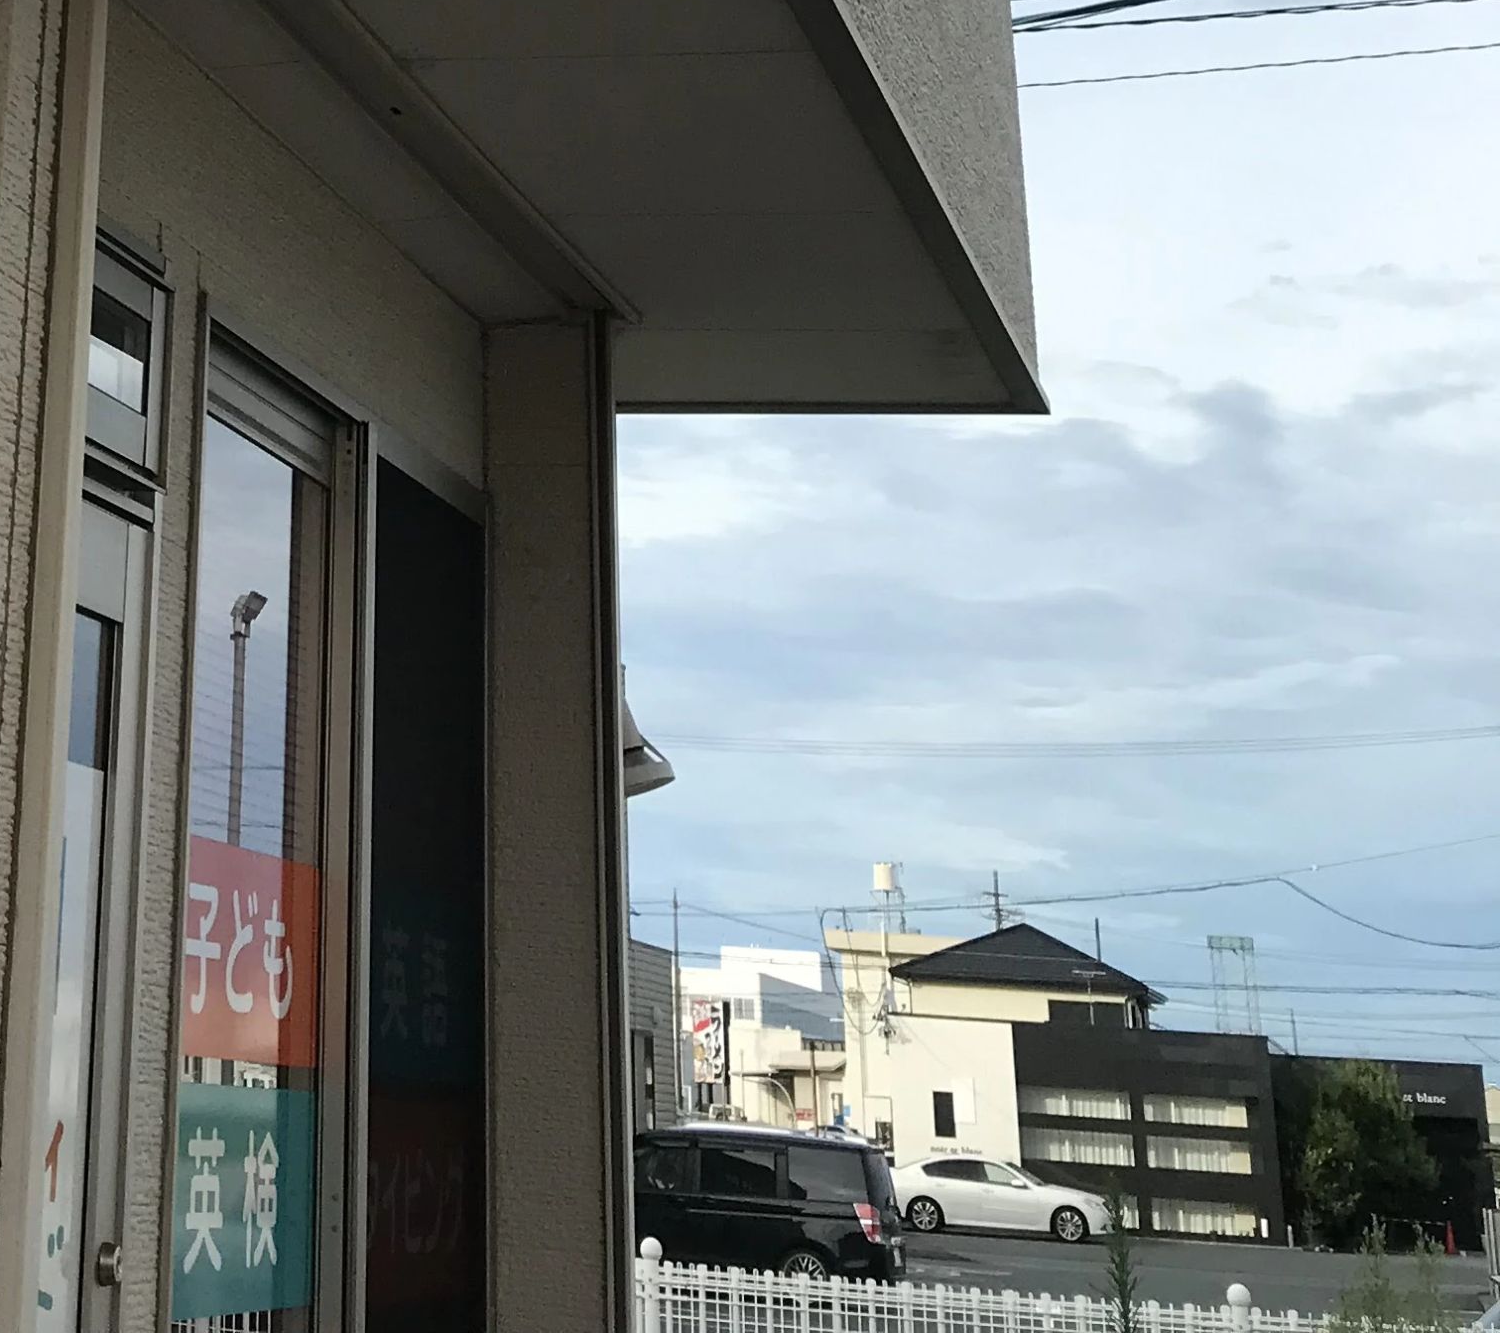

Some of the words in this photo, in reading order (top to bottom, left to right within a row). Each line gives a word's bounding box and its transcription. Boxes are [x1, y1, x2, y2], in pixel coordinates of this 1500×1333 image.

[182, 881, 295, 1021] 子ども
[1415, 1092, 1447, 1105] blanc
[182, 1124, 280, 1274] 英検
